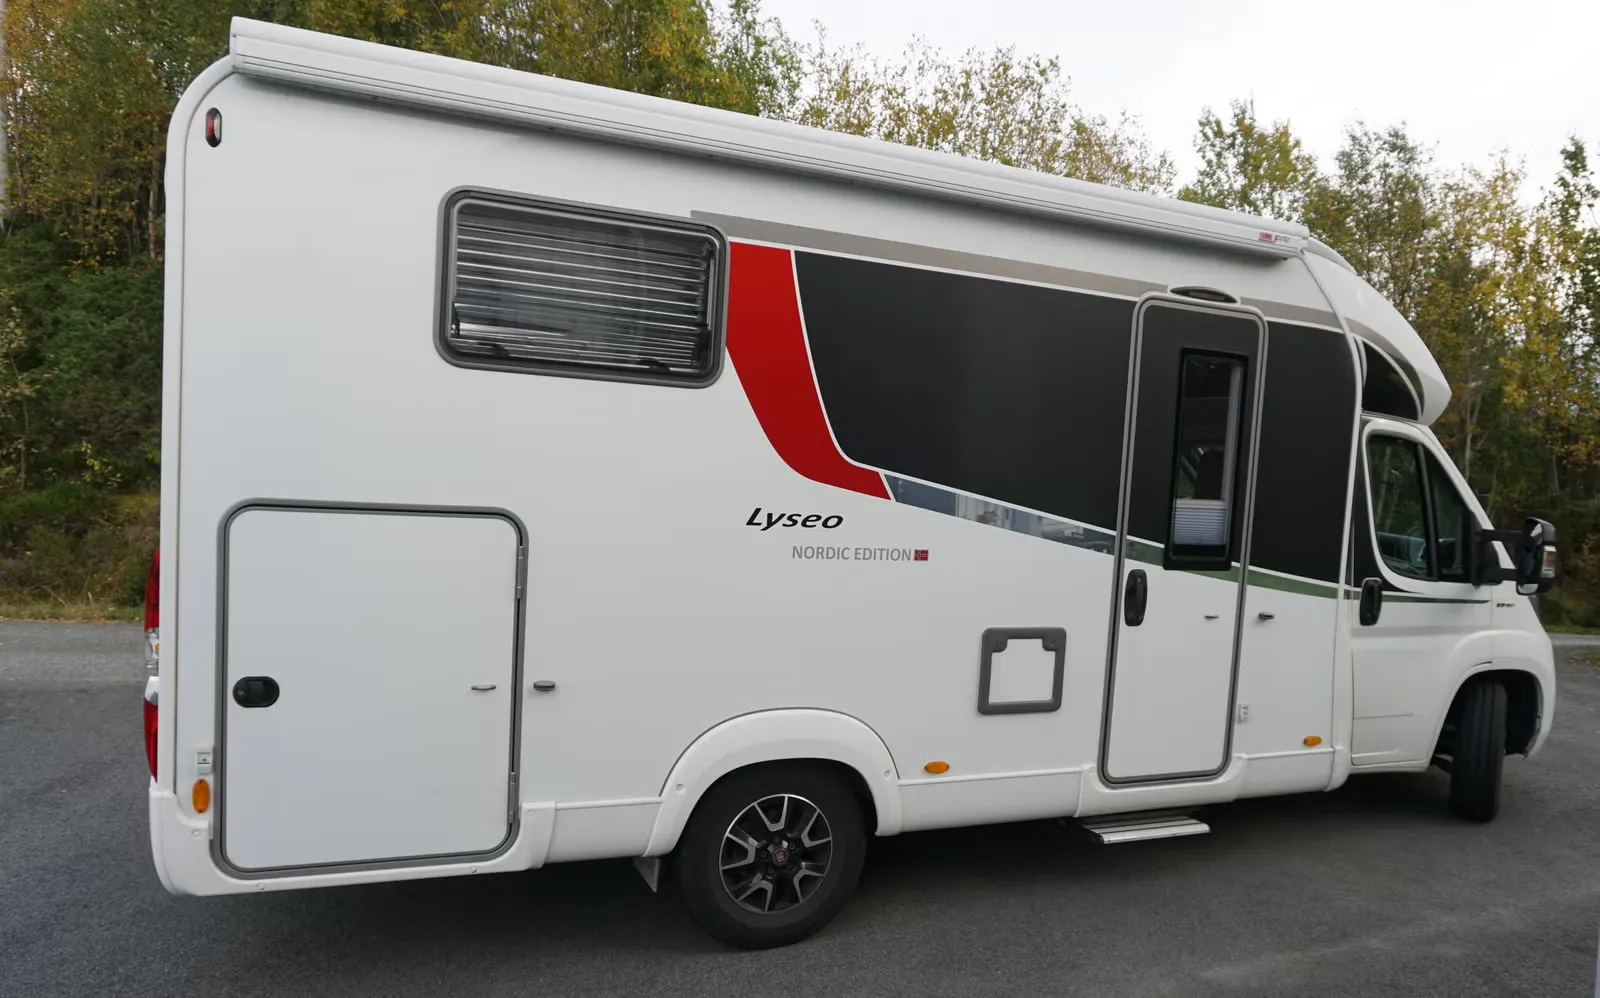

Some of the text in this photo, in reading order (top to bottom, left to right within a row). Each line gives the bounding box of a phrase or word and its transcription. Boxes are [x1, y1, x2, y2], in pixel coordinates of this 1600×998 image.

[746, 507, 844, 531] Lyseo
[792, 545, 912, 562] NORDIC EDITION
